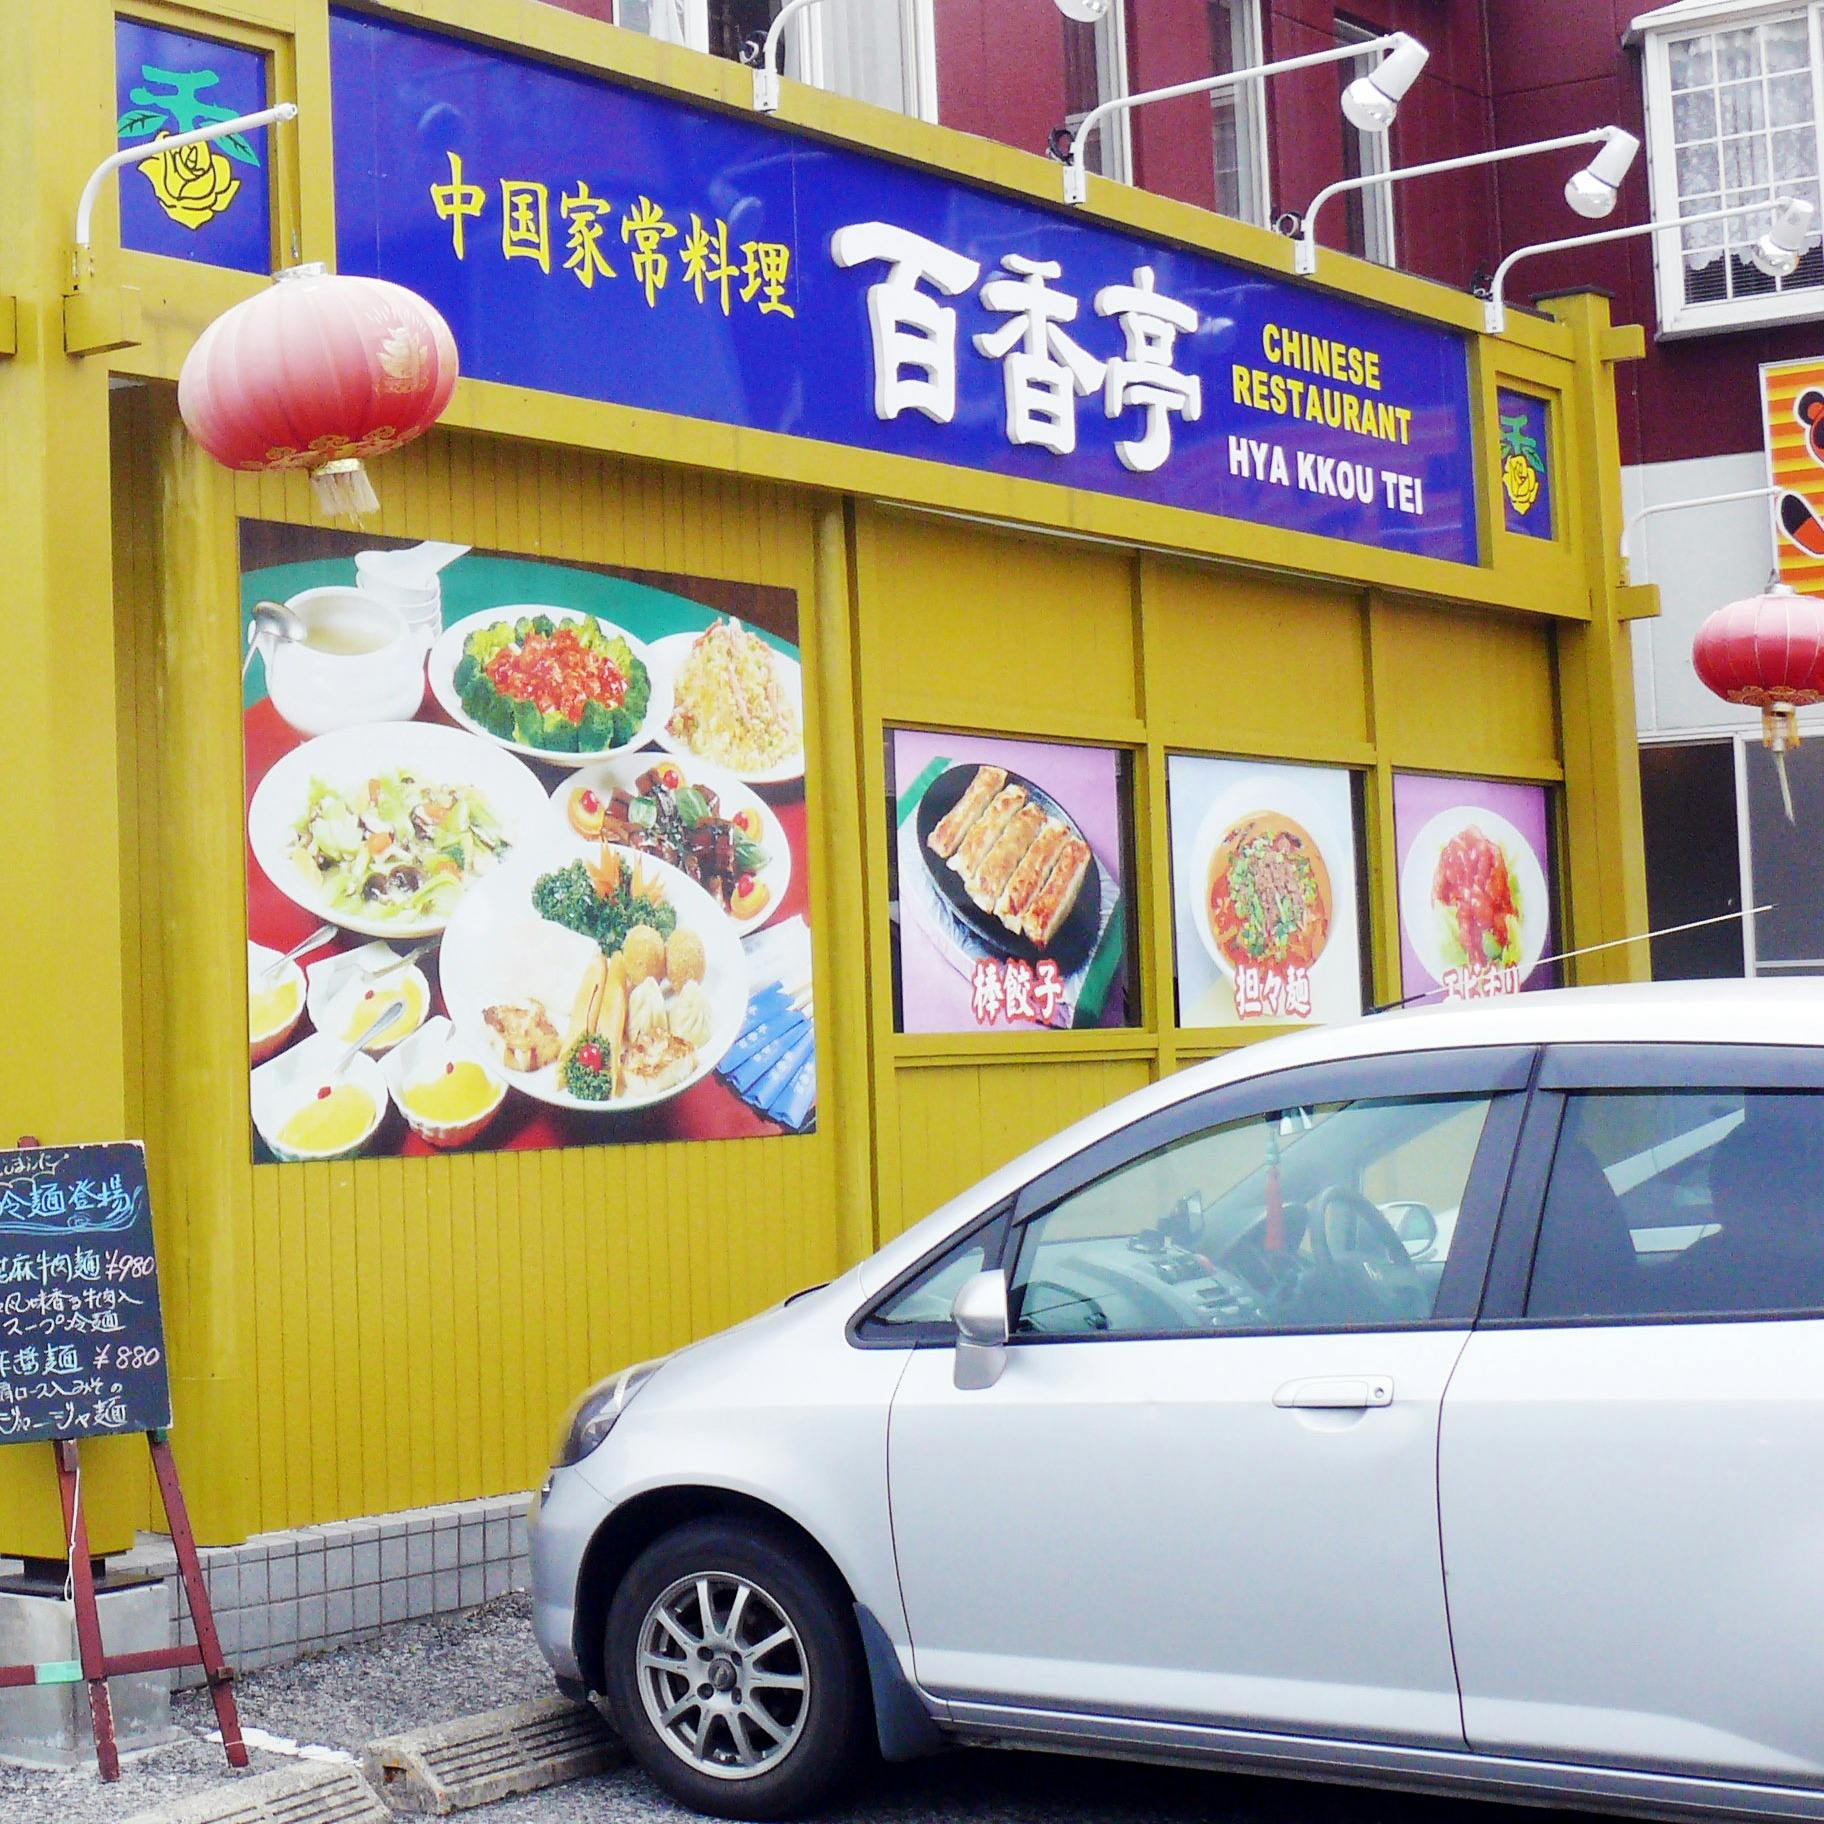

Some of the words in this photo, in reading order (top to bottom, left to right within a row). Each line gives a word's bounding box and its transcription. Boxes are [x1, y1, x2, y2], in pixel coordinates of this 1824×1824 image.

[430, 151, 796, 319] 中国家常料理
[830, 220, 1202, 473] 百香亭
[1263, 323, 1381, 390] CHINESE
[1232, 364, 1412, 445] RESTAURANT
[1228, 436, 1289, 486] HYA
[1297, 451, 1374, 504] KKOU
[1381, 471, 1424, 514] TEI
[973, 961, 1064, 1023] 棒餃子
[1236, 964, 1312, 1018] 担々麺
